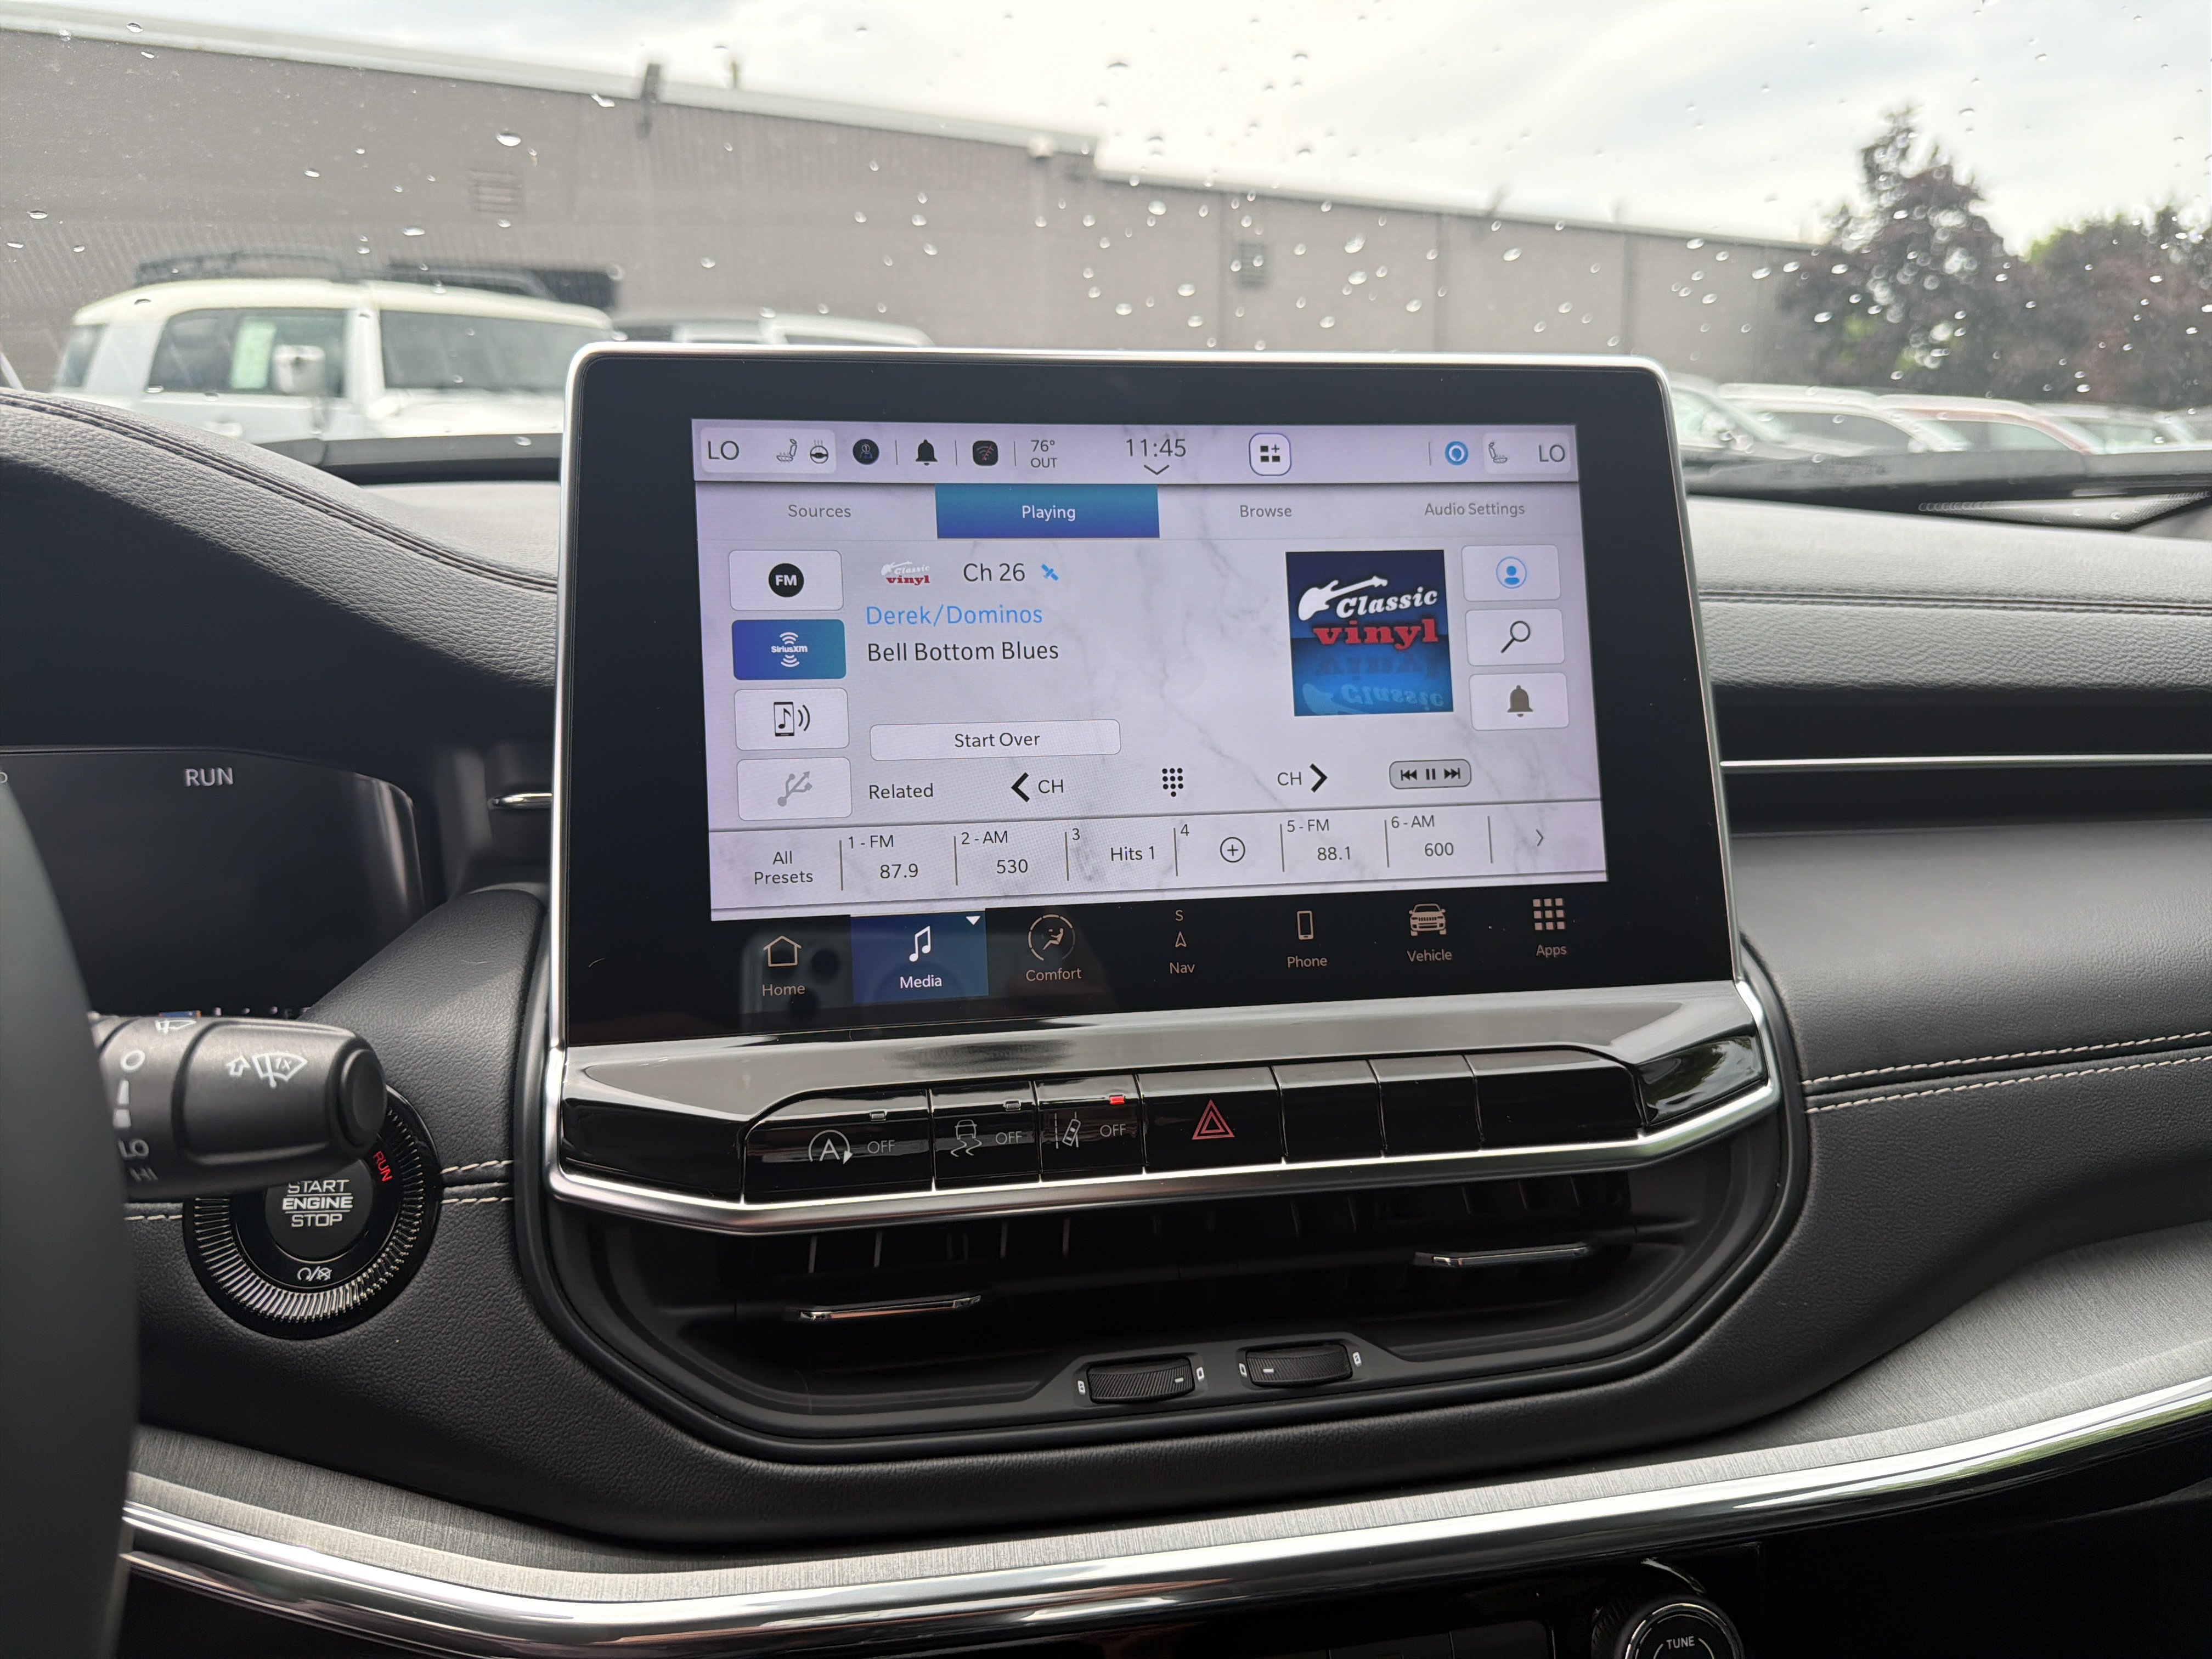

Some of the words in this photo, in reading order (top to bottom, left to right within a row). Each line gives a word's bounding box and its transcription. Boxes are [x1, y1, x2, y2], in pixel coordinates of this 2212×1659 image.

[708, 441, 739, 460] LO
[1126, 439, 1187, 458] 11:45
[1539, 444, 1565, 462] LO
[1030, 458, 1058, 468] OUT
[788, 504, 851, 518] Sources
[1022, 505, 1076, 521] Playing
[1239, 504, 1292, 518] Browse
[1425, 502, 1465, 516] Audio
[1468, 501, 1525, 518] Settings
[963, 563, 992, 582] Ch
[1000, 563, 1025, 581] 26
[775, 575, 797, 586] FM
[886, 575, 930, 585] vinyl
[1336, 586, 1437, 618] Classic
[866, 604, 1042, 627] Derek/Dominos
[1313, 618, 1438, 650] vinyl
[868, 643, 907, 662] Bell
[916, 642, 994, 661] Bottom
[1002, 641, 1058, 659] Blues
[955, 733, 995, 748] Start
[1000, 732, 1040, 747] Over
[185, 767, 233, 786] RUN
[1277, 772, 1302, 786] CH
[869, 782, 934, 799] Related
[1038, 780, 1064, 794] CH
[1308, 819, 1330, 831] FM
[1411, 815, 1435, 827] AM
[982, 831, 1008, 844] AM
[1072, 828, 1080, 840] 3
[1180, 825, 1190, 837] 4
[870, 835, 894, 848] FM
[1110, 847, 1143, 861] Hits
[1149, 847, 1155, 860] 1
[1317, 847, 1351, 861] 88.1
[1424, 842, 1454, 856] 600
[772, 850, 792, 865] All
[879, 864, 919, 879] 87.9
[996, 859, 1029, 873] 530
[754, 870, 813, 885] Presets
[1175, 910, 1183, 922] S
[1407, 949, 1452, 963] Vehicle
[1537, 944, 1567, 959] Apps
[1170, 961, 1195, 974] Nav
[1287, 954, 1328, 968] Phone
[900, 974, 942, 989] Media
[1026, 968, 1081, 982] Comfort
[762, 983, 805, 996] Home
[1099, 1122, 1127, 1137] OFF
[995, 1131, 1023, 1145] OFF
[867, 1139, 895, 1154] OFF
[373, 1151, 393, 1183] RUN
[287, 1180, 350, 1194] START
[282, 1197, 353, 1210] ENGINE
[291, 1214, 343, 1227] STOP
[1666, 1635, 1696, 1649] TUNE
